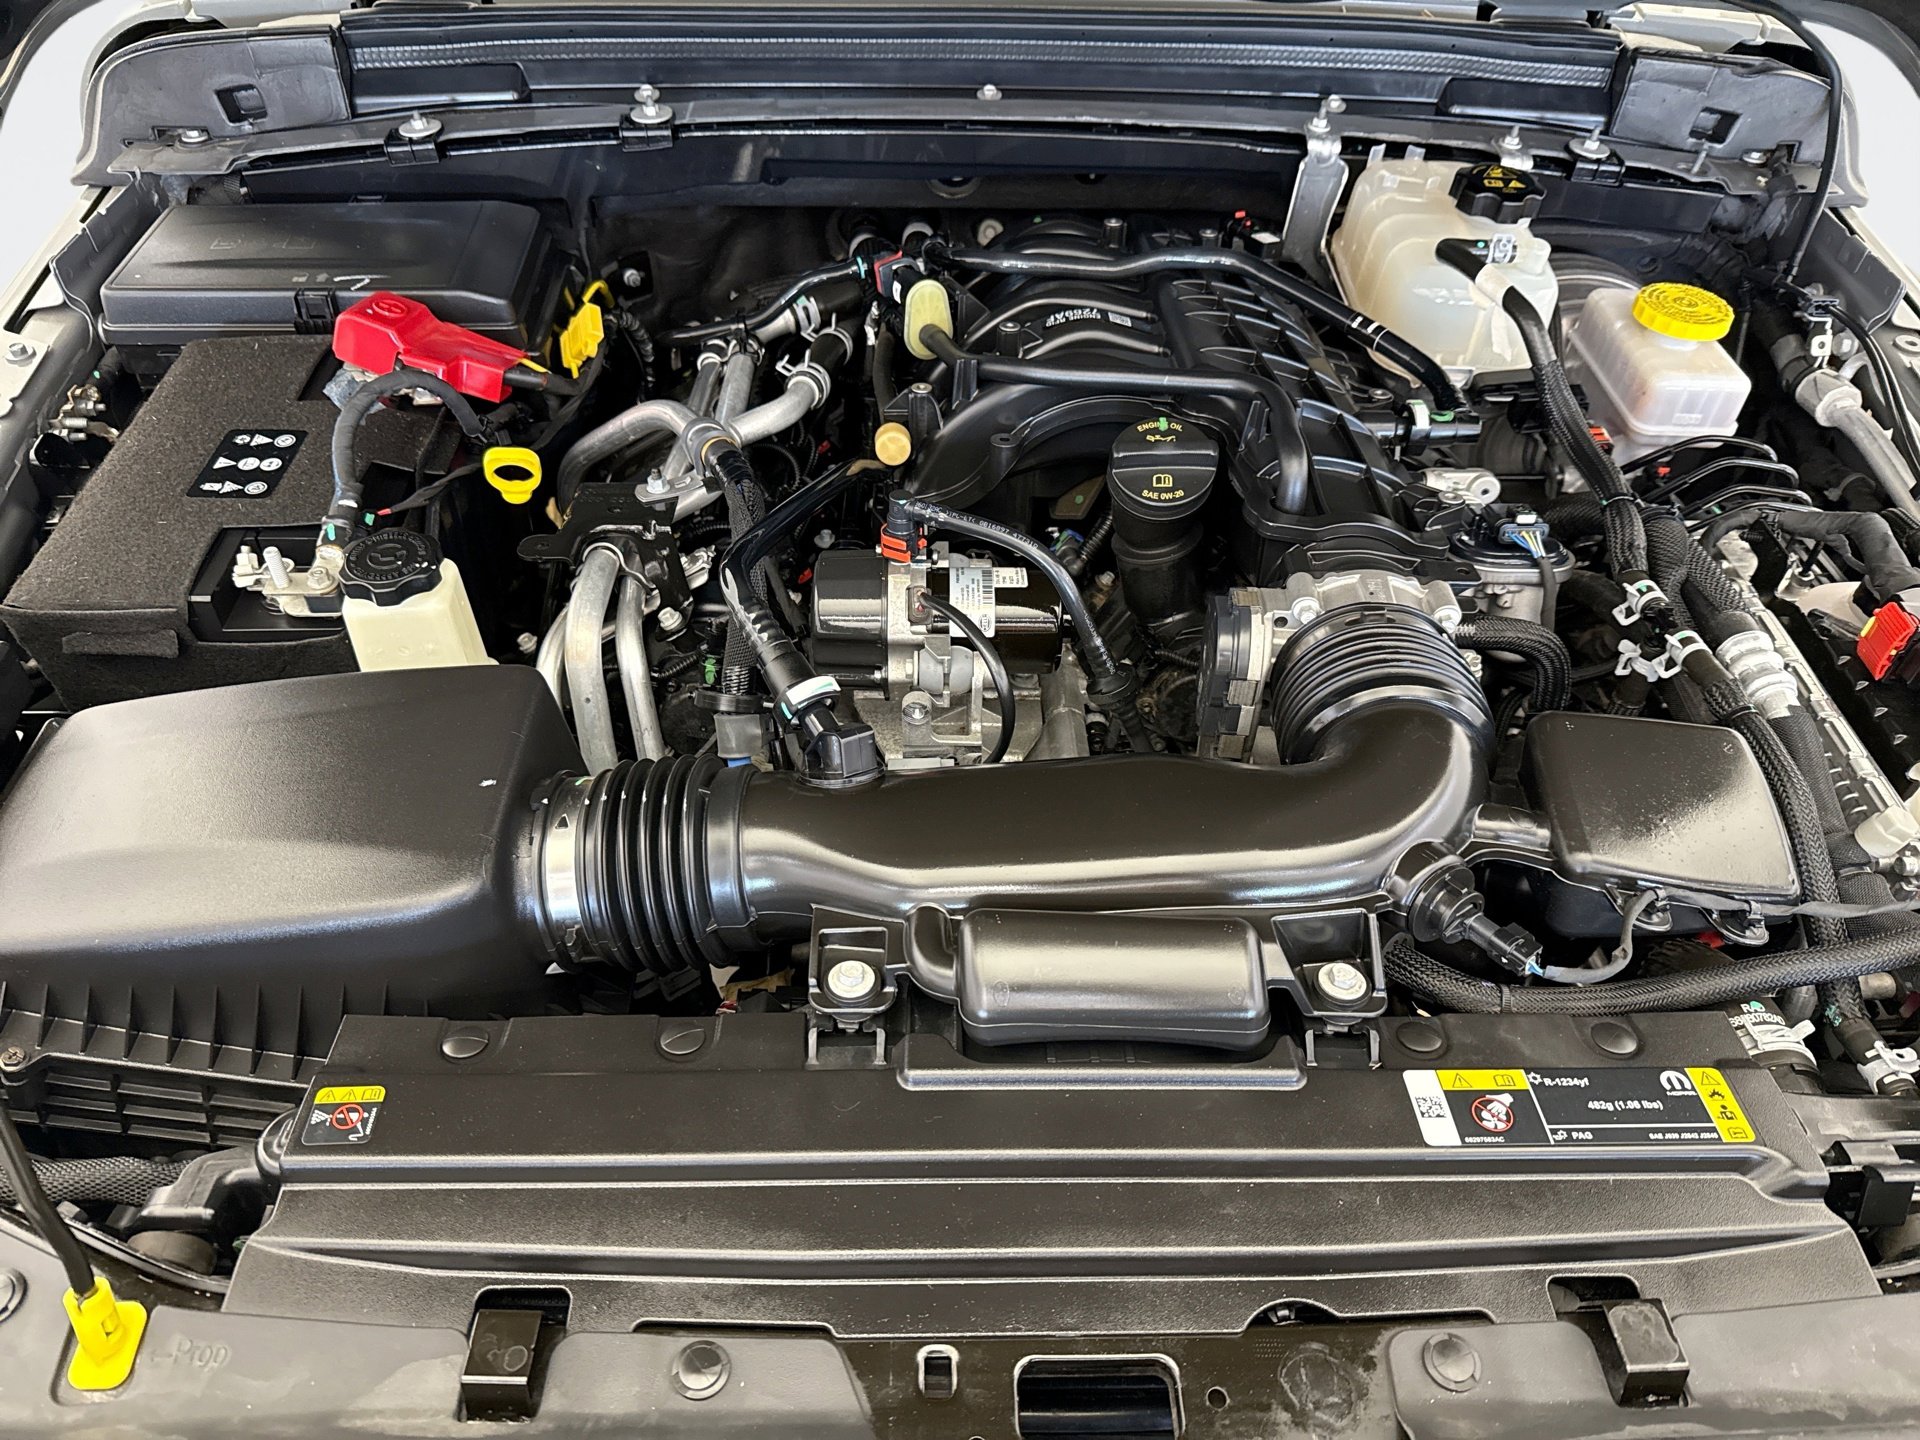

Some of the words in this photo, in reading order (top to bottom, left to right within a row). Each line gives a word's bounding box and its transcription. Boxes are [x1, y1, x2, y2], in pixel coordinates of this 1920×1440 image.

[1137, 421, 1168, 432] ENGI
[1170, 423, 1183, 432] OIL
[1142, 490, 1159, 500] SAE
[1160, 489, 1185, 500] 0W-20
[1587, 1100, 1614, 1111] 482g
[1641, 1100, 1664, 1111] lbs)
[1571, 1131, 1593, 1140] PAG
